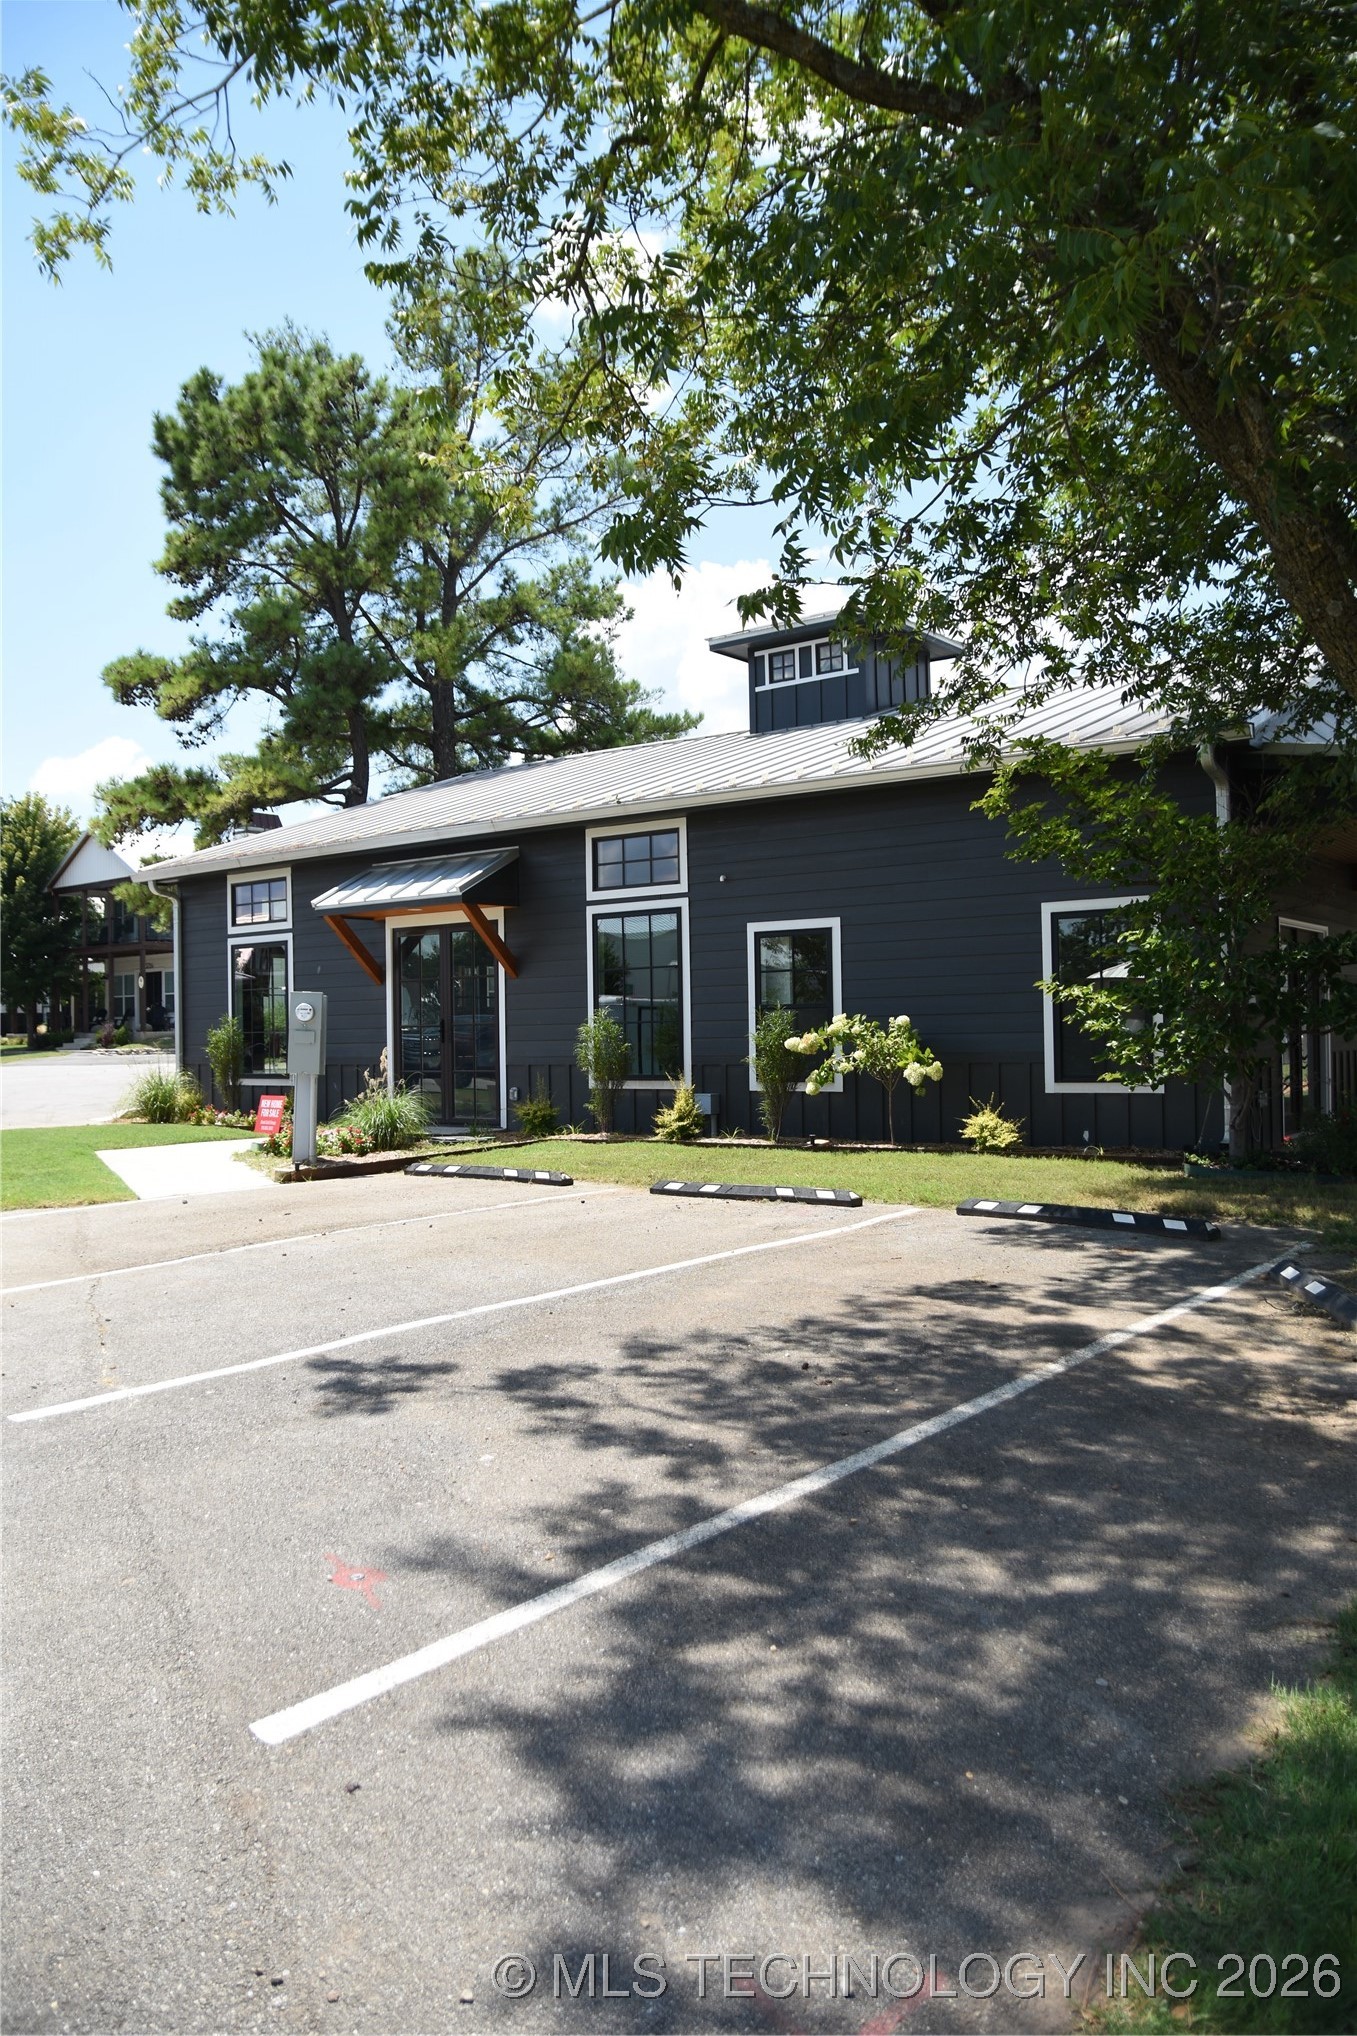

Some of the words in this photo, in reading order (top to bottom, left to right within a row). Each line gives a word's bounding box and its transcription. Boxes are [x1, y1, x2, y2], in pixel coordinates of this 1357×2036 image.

[261, 1100, 271, 1108] NEW
[270, 1100, 283, 1108] HOME
[260, 1109, 269, 1117] FOR
[269, 1109, 280, 1117] SALE
